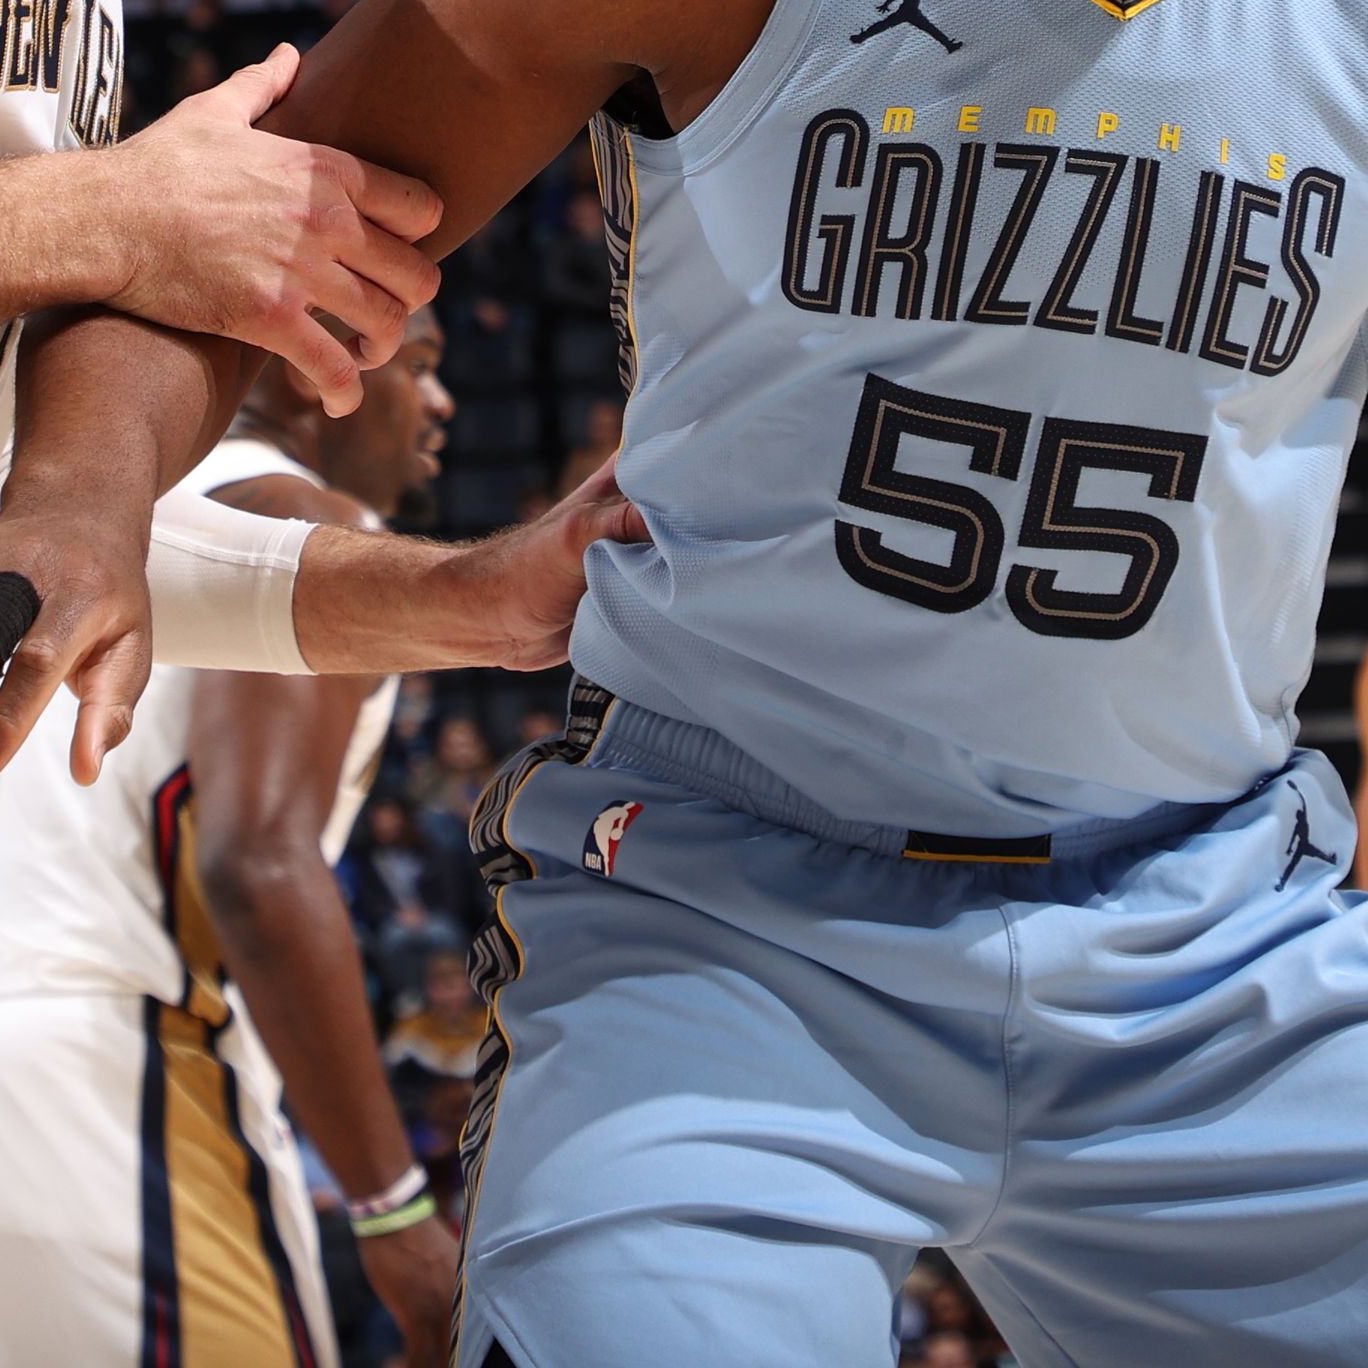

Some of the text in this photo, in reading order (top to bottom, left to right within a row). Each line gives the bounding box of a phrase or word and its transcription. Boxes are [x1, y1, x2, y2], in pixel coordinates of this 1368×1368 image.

[882, 106, 1287, 182] MEMPHIS
[780, 108, 1346, 378] GRIZZLIES
[834, 372, 1209, 641] 55
[585, 852, 602, 871] NBA
